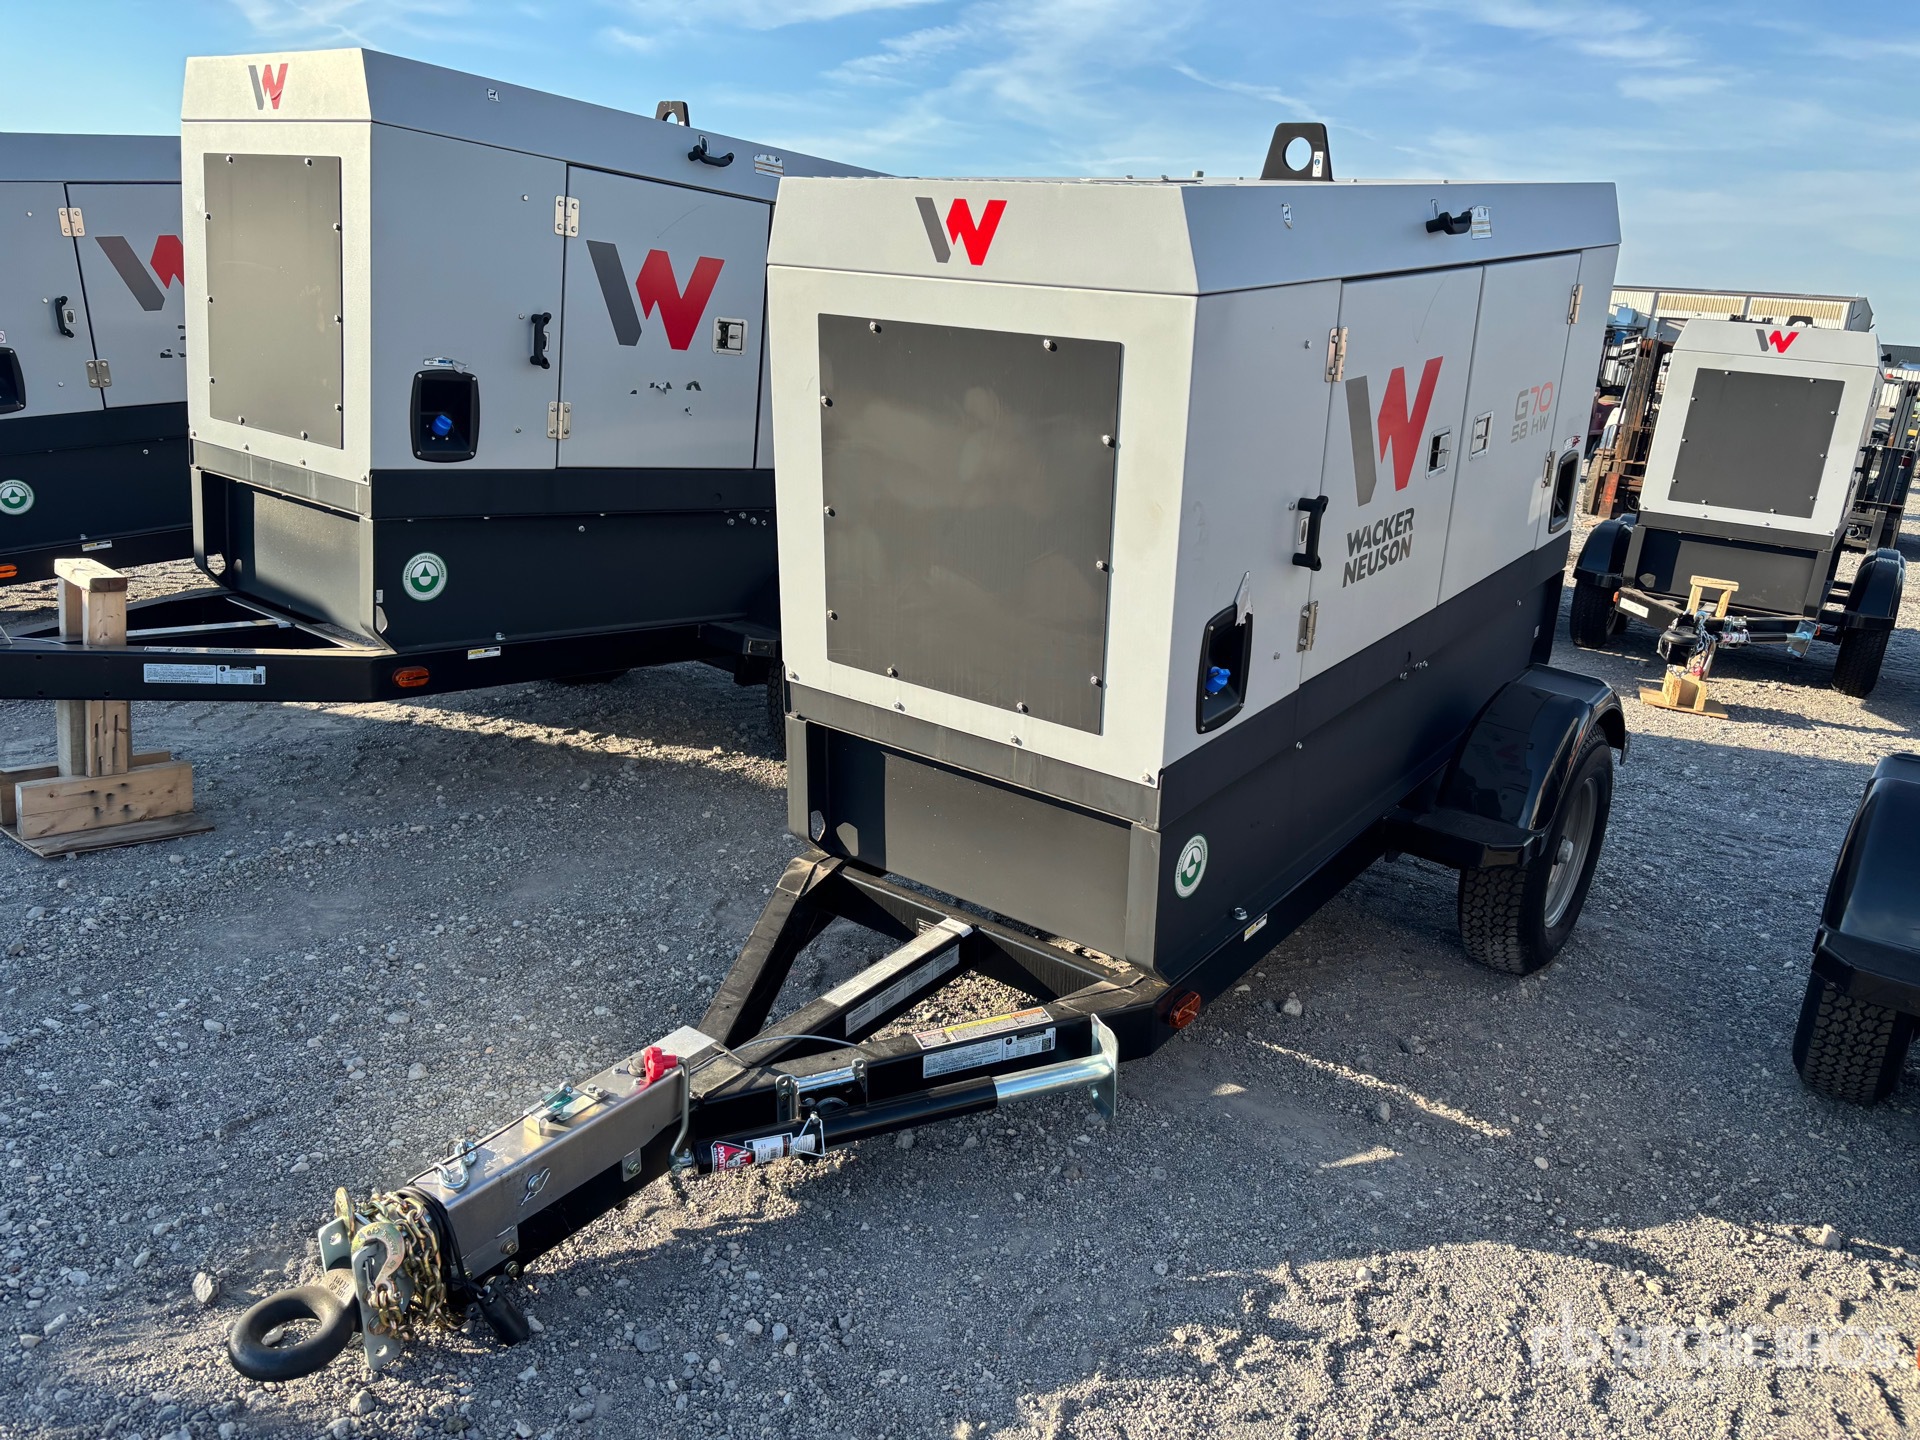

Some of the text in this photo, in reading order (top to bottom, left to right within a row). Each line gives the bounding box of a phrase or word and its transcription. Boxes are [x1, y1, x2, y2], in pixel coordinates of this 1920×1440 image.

[1515, 381, 1554, 421] G70
[1346, 507, 1415, 557] WACKER
[1342, 533, 1413, 588] NEUSON
